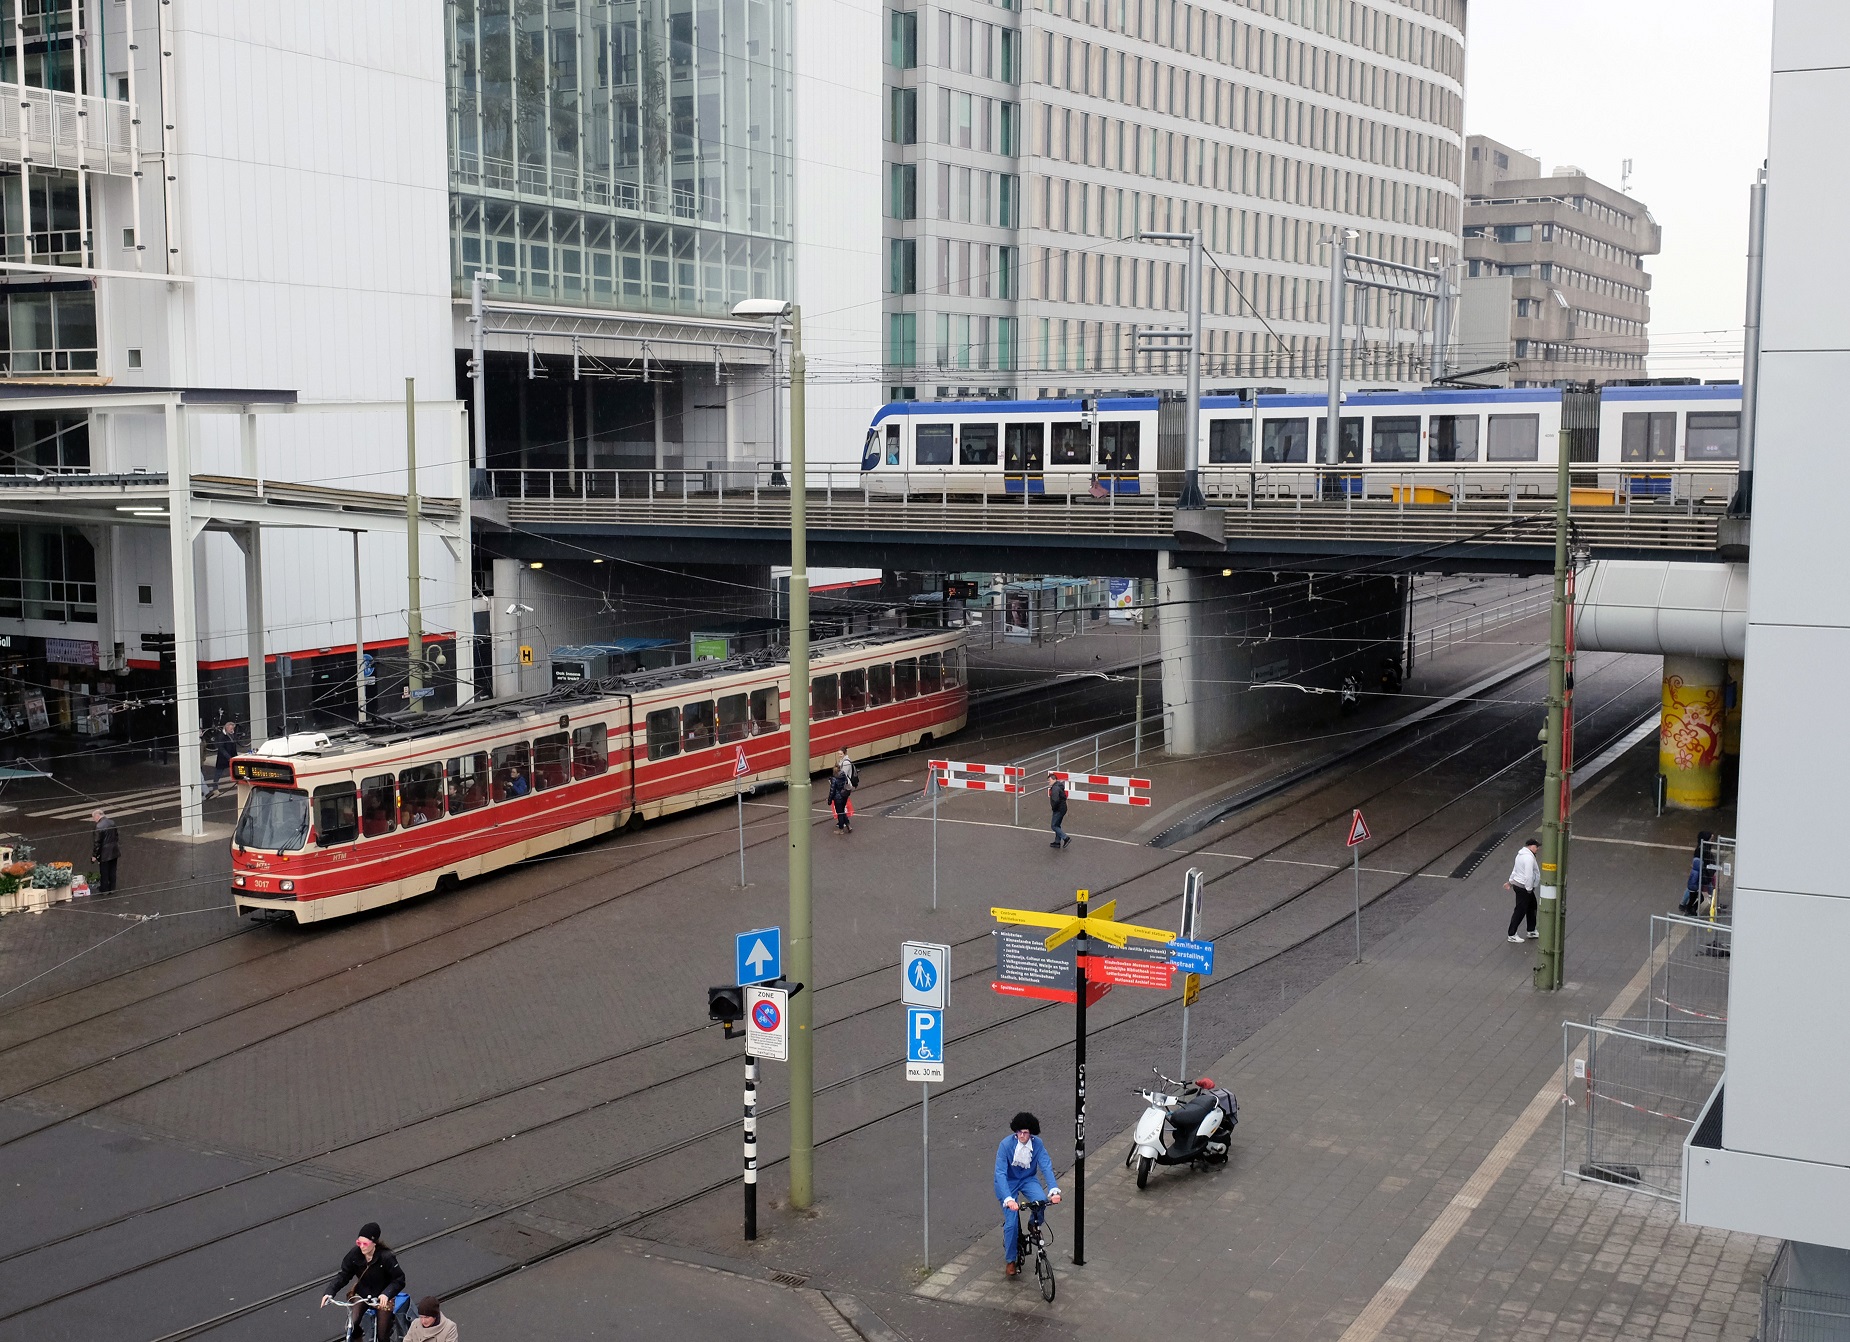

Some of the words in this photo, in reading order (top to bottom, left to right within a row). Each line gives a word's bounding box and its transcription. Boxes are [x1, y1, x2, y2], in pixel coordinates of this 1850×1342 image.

[523, 650, 531, 661] H
[332, 853, 347, 861] HTM
[254, 880, 270, 888] 3017
[916, 1012, 935, 1040] P
[931, 1069, 941, 1077] min.
